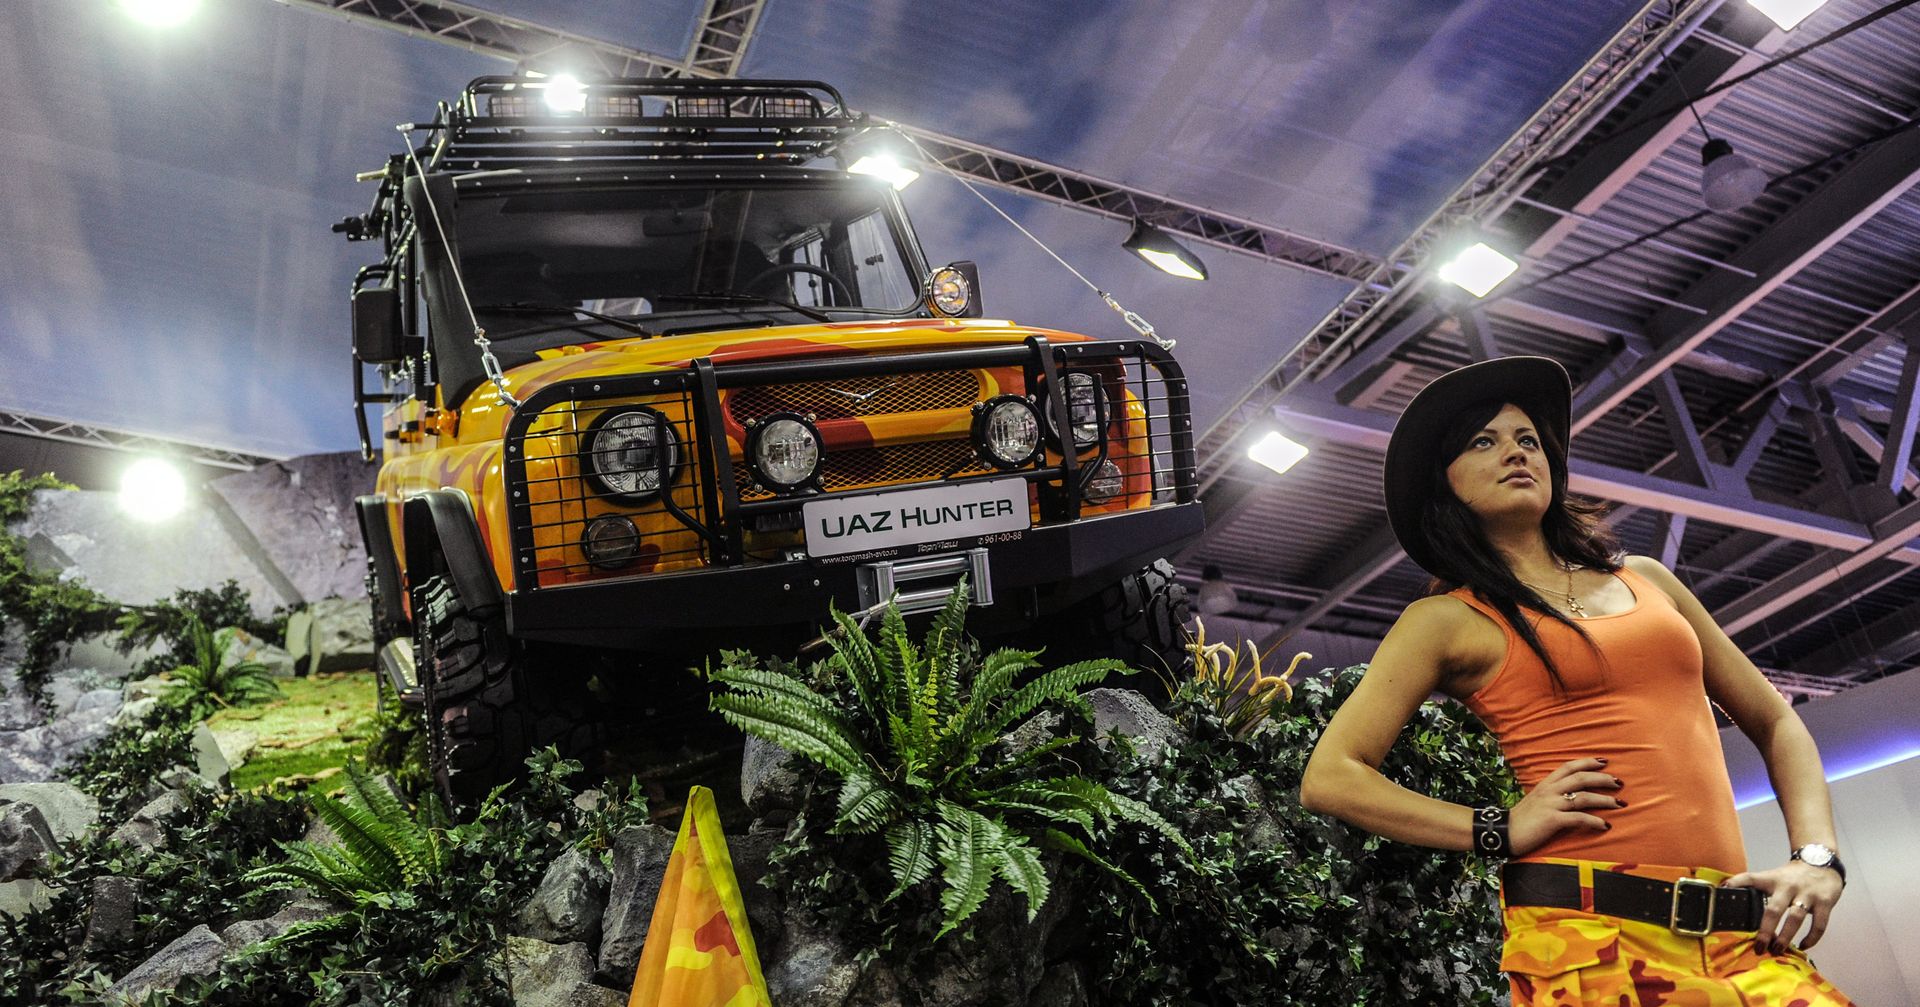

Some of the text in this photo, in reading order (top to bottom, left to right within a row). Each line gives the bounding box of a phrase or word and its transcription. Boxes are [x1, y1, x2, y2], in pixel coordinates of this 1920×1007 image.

[822, 499, 1014, 538] UAZ HUNTER
[984, 531, 1022, 544] 961-00-88
[822, 548, 898, 564] www.torgmash-avto.ru
